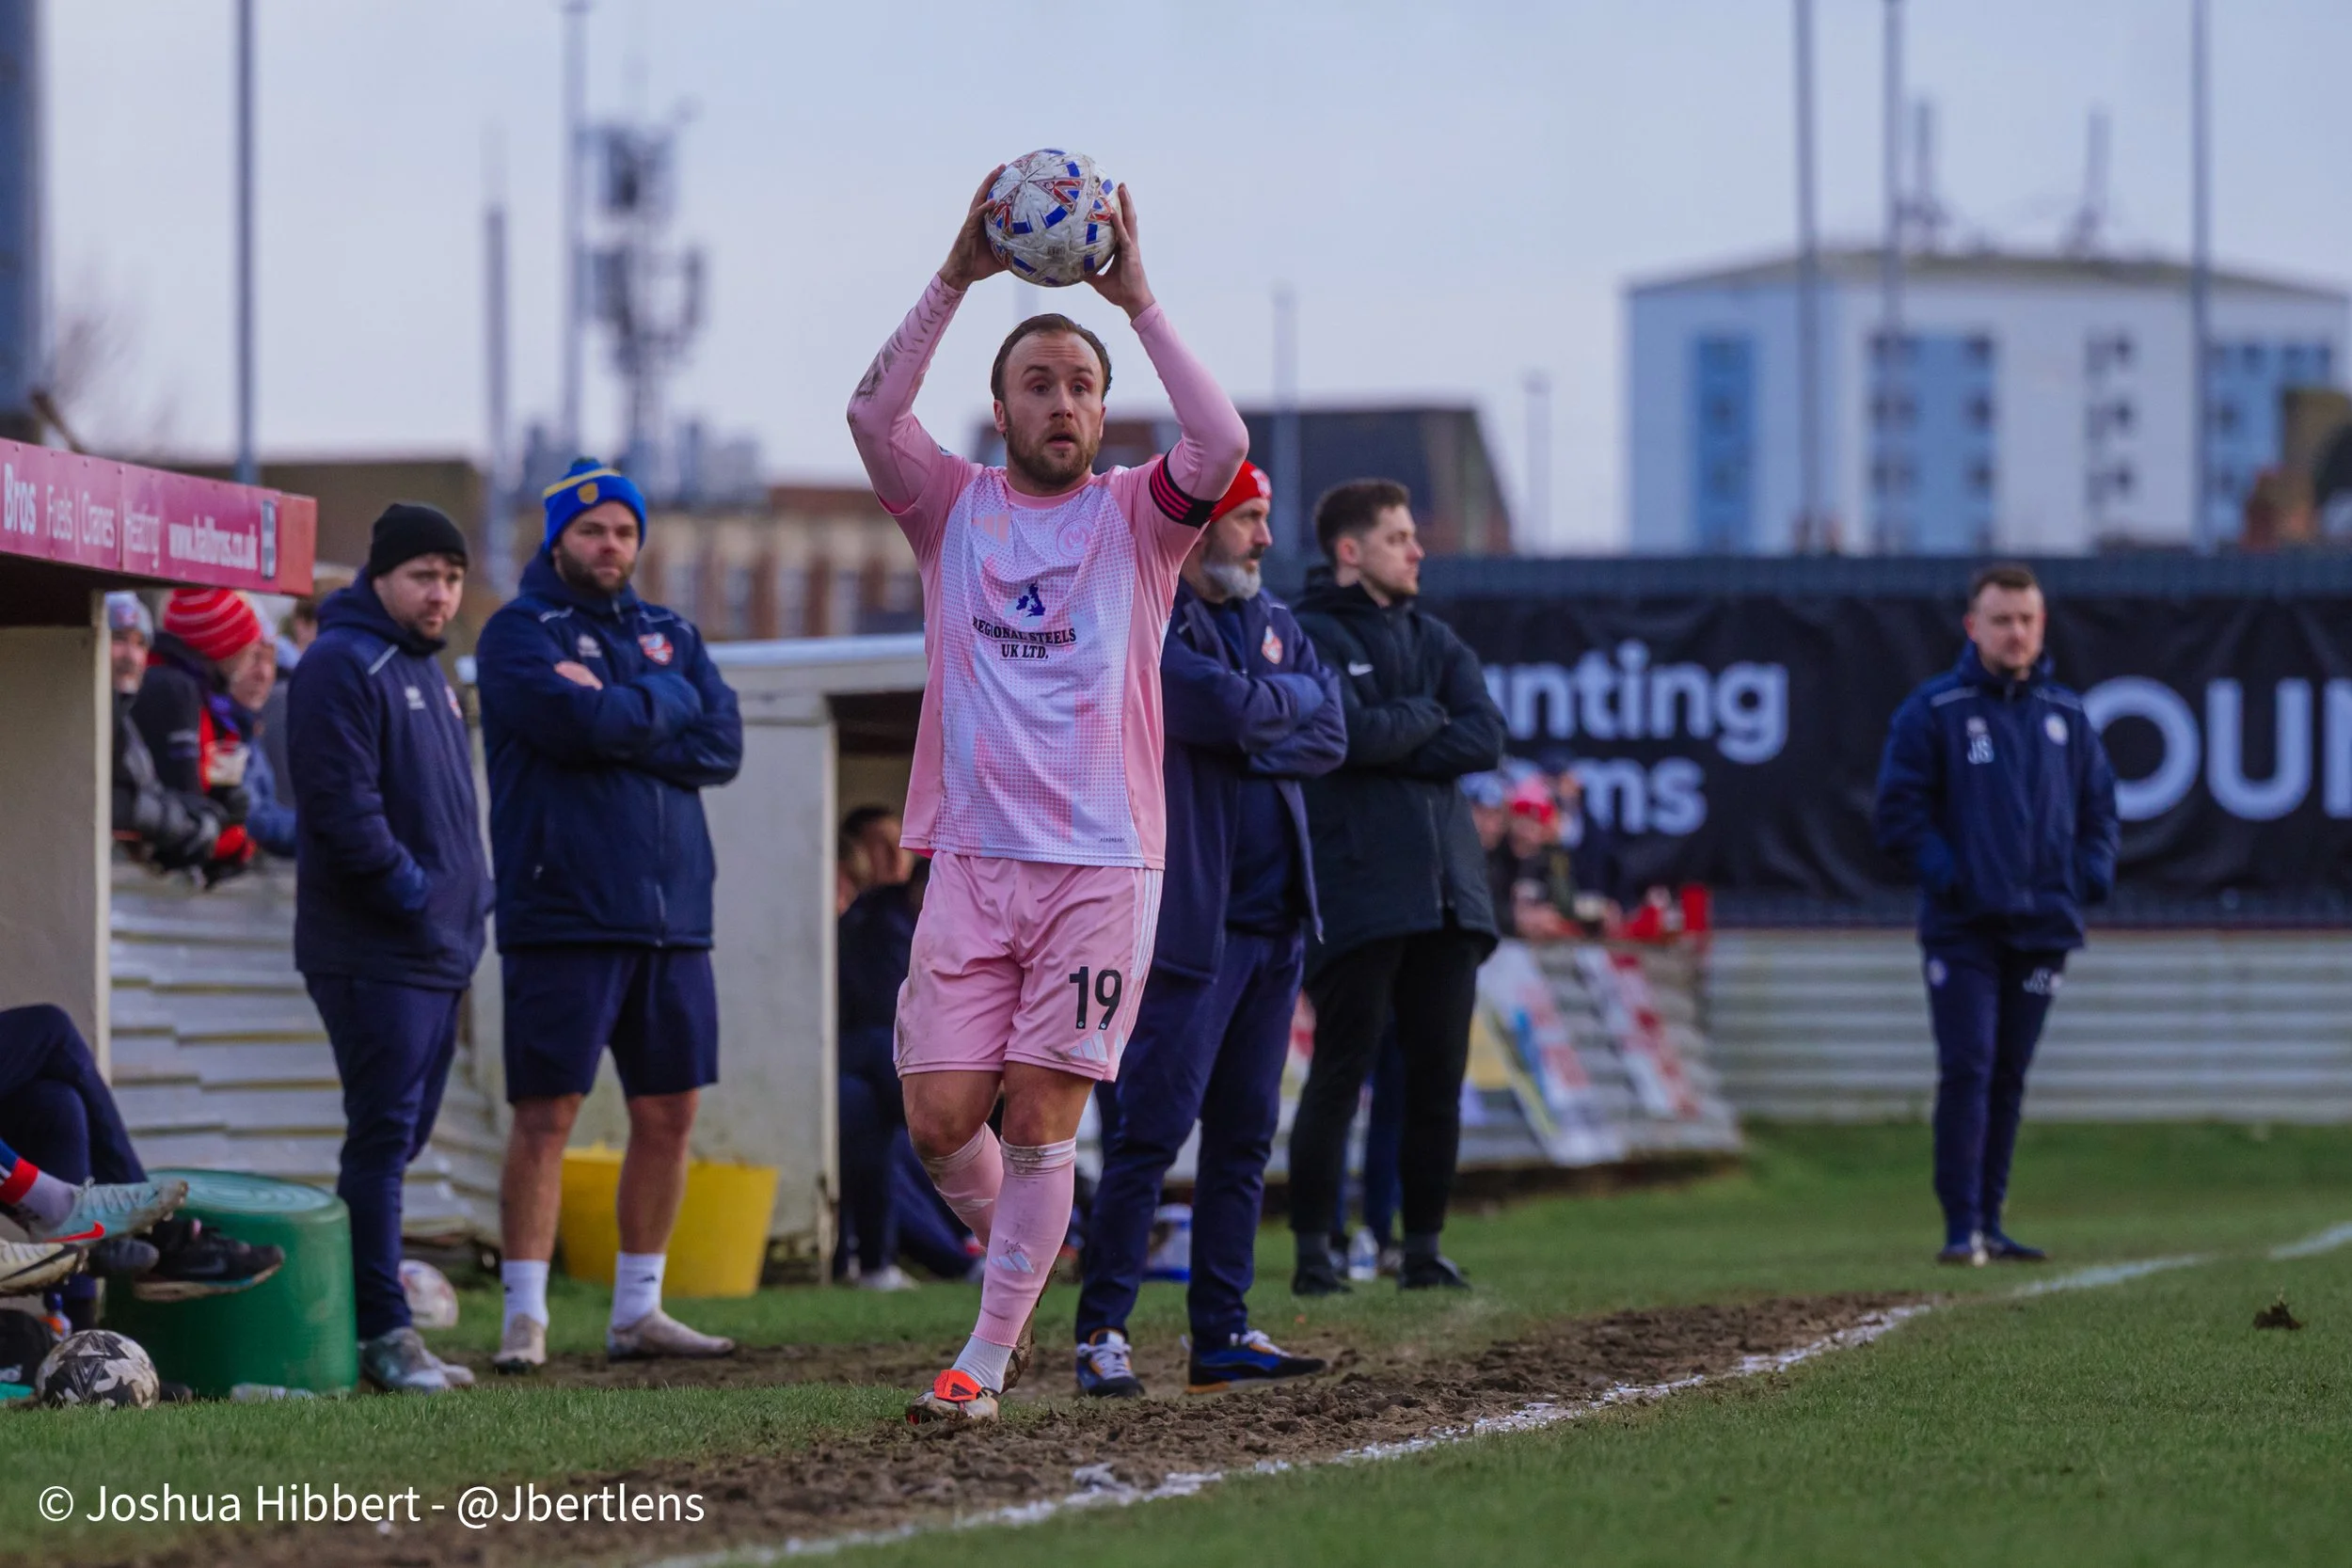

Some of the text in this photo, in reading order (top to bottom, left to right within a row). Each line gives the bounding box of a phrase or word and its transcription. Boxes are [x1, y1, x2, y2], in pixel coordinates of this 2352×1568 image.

[4, 463, 37, 535] Bros
[972, 616, 1076, 644] REGIONAL STEELS
[1001, 643, 1049, 659] UK LTD.
[1069, 966, 1122, 1031] 19
